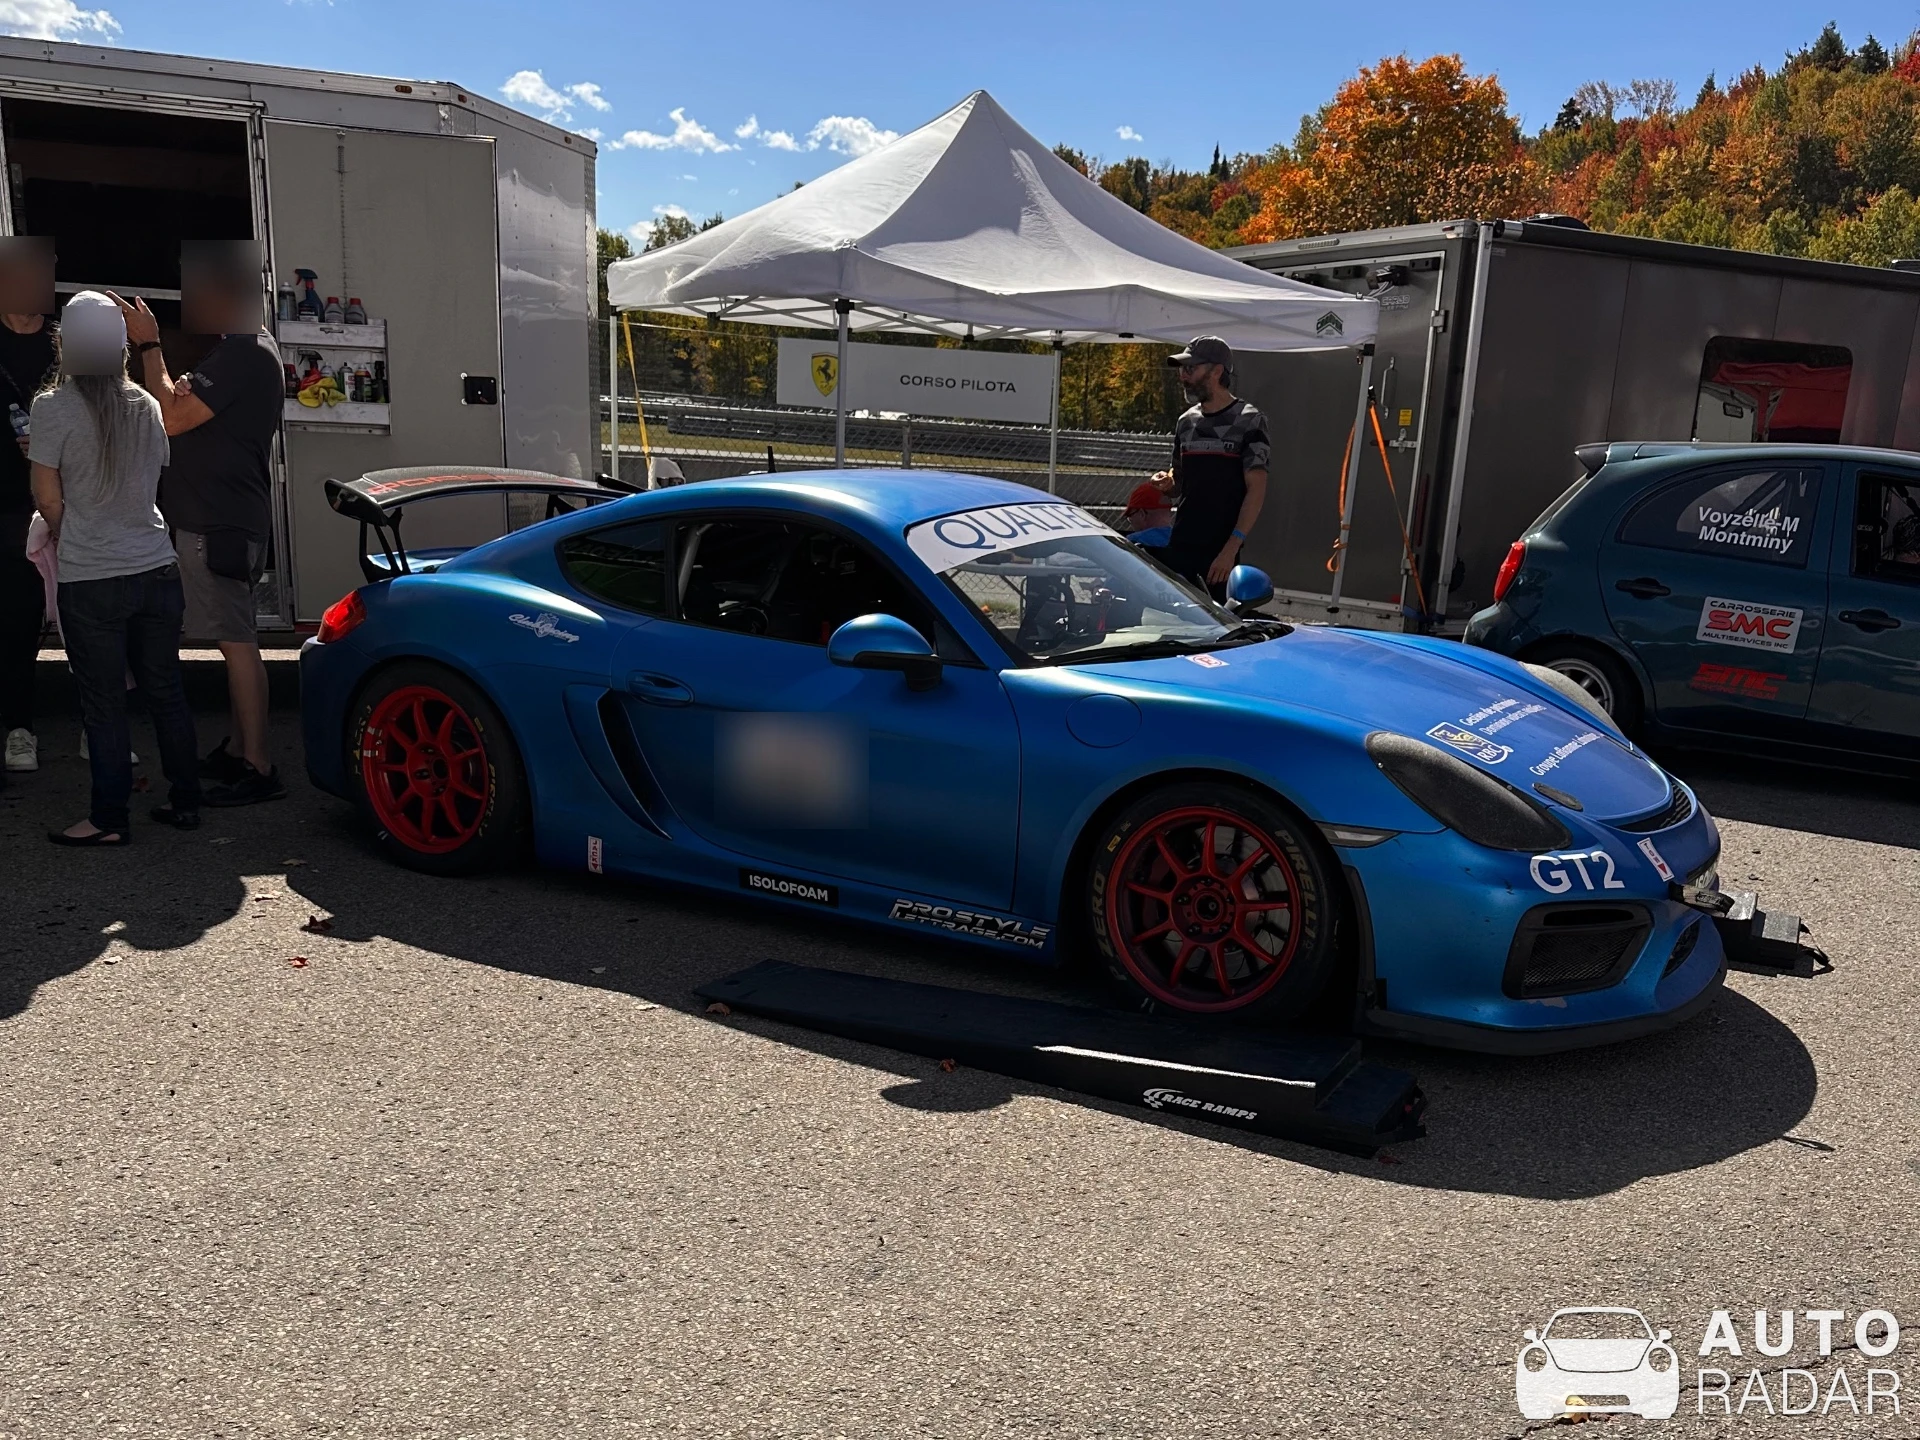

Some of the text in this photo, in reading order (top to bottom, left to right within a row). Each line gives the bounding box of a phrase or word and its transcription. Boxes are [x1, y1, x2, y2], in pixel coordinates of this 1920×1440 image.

[900, 374, 1017, 393] CORSO PILOTA
[1698, 525, 1794, 554] Montminy
[1710, 600, 1796, 619] CARROSSERIE
[1705, 609, 1794, 640] SMC
[1702, 631, 1772, 647] MULTISERVICES
[1476, 743, 1503, 762] RBC
[1529, 755, 1560, 776] Groupe
[591, 840, 599, 863] JACK
[1274, 829, 1318, 939] PIRELLI
[1529, 850, 1626, 894] GT2
[749, 874, 829, 902] ISOLOFOAM
[1092, 869, 1113, 958] ZERO
[895, 911, 1045, 949] LETTRAGE.COM
[1160, 1093, 1258, 1120] RACE RAMPS
